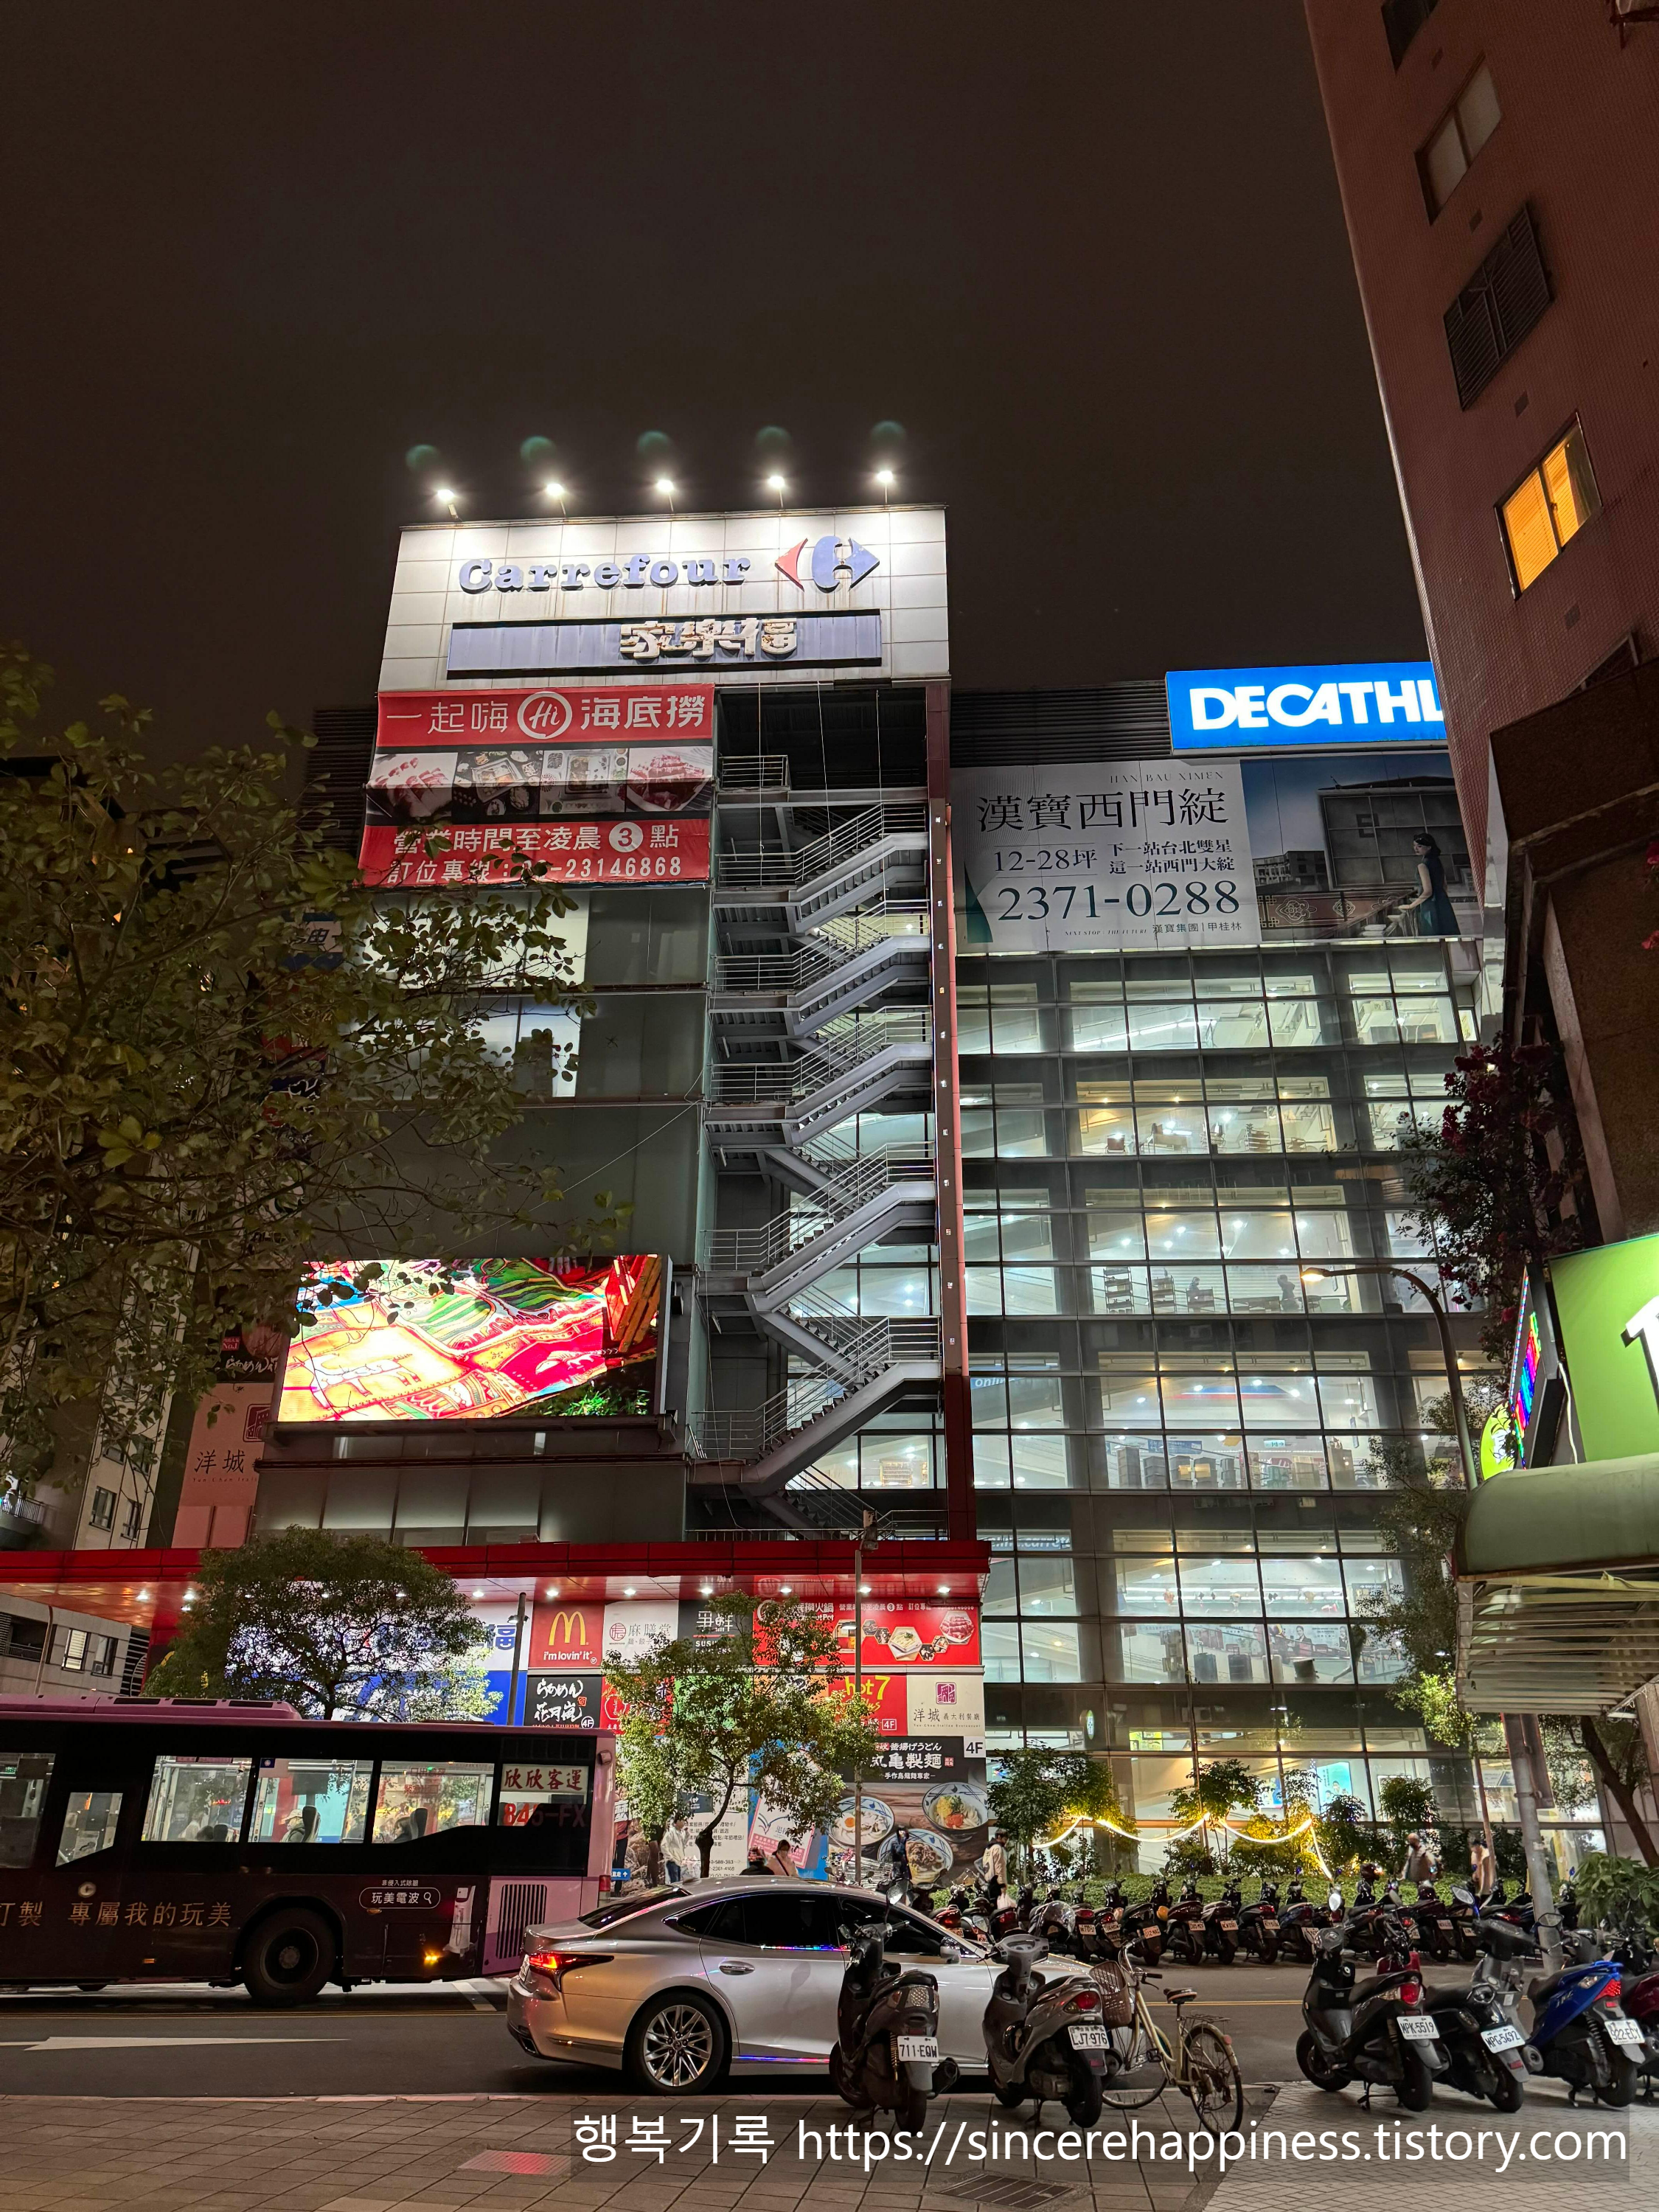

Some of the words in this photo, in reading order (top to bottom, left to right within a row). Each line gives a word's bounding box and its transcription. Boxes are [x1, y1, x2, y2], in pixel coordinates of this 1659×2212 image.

[459, 554, 751, 594] Carrefour
[620, 618, 797, 660] 家樂福
[386, 700, 509, 734] 一起嗨
[580, 695, 706, 730] 海底撈
[1190, 679, 1444, 731] DECATHL
[976, 787, 1229, 832] 漢寶西門綻
[1107, 839, 1233, 857] 下一站台北雙星
[522, 855, 682, 880] 0-23146868
[995, 849, 1098, 872] 12-28坪
[997, 880, 1240, 921] 2371-0288
[194, 1449, 246, 1474] 洋城
[543, 1651, 557, 1660] i'm
[557, 1651, 582, 1660] lovin'
[883, 1721, 894, 1729] 4F
[914, 1708, 940, 1722] 洋城
[966, 1742, 984, 1754] 4F
[504, 1767, 583, 1791] 欣欣客運
[371, 1892, 420, 1904] 玩美電波
[67, 1901, 232, 1927] 專屬我的玩美
[1399, 2021, 1435, 2034] MPK-5519
